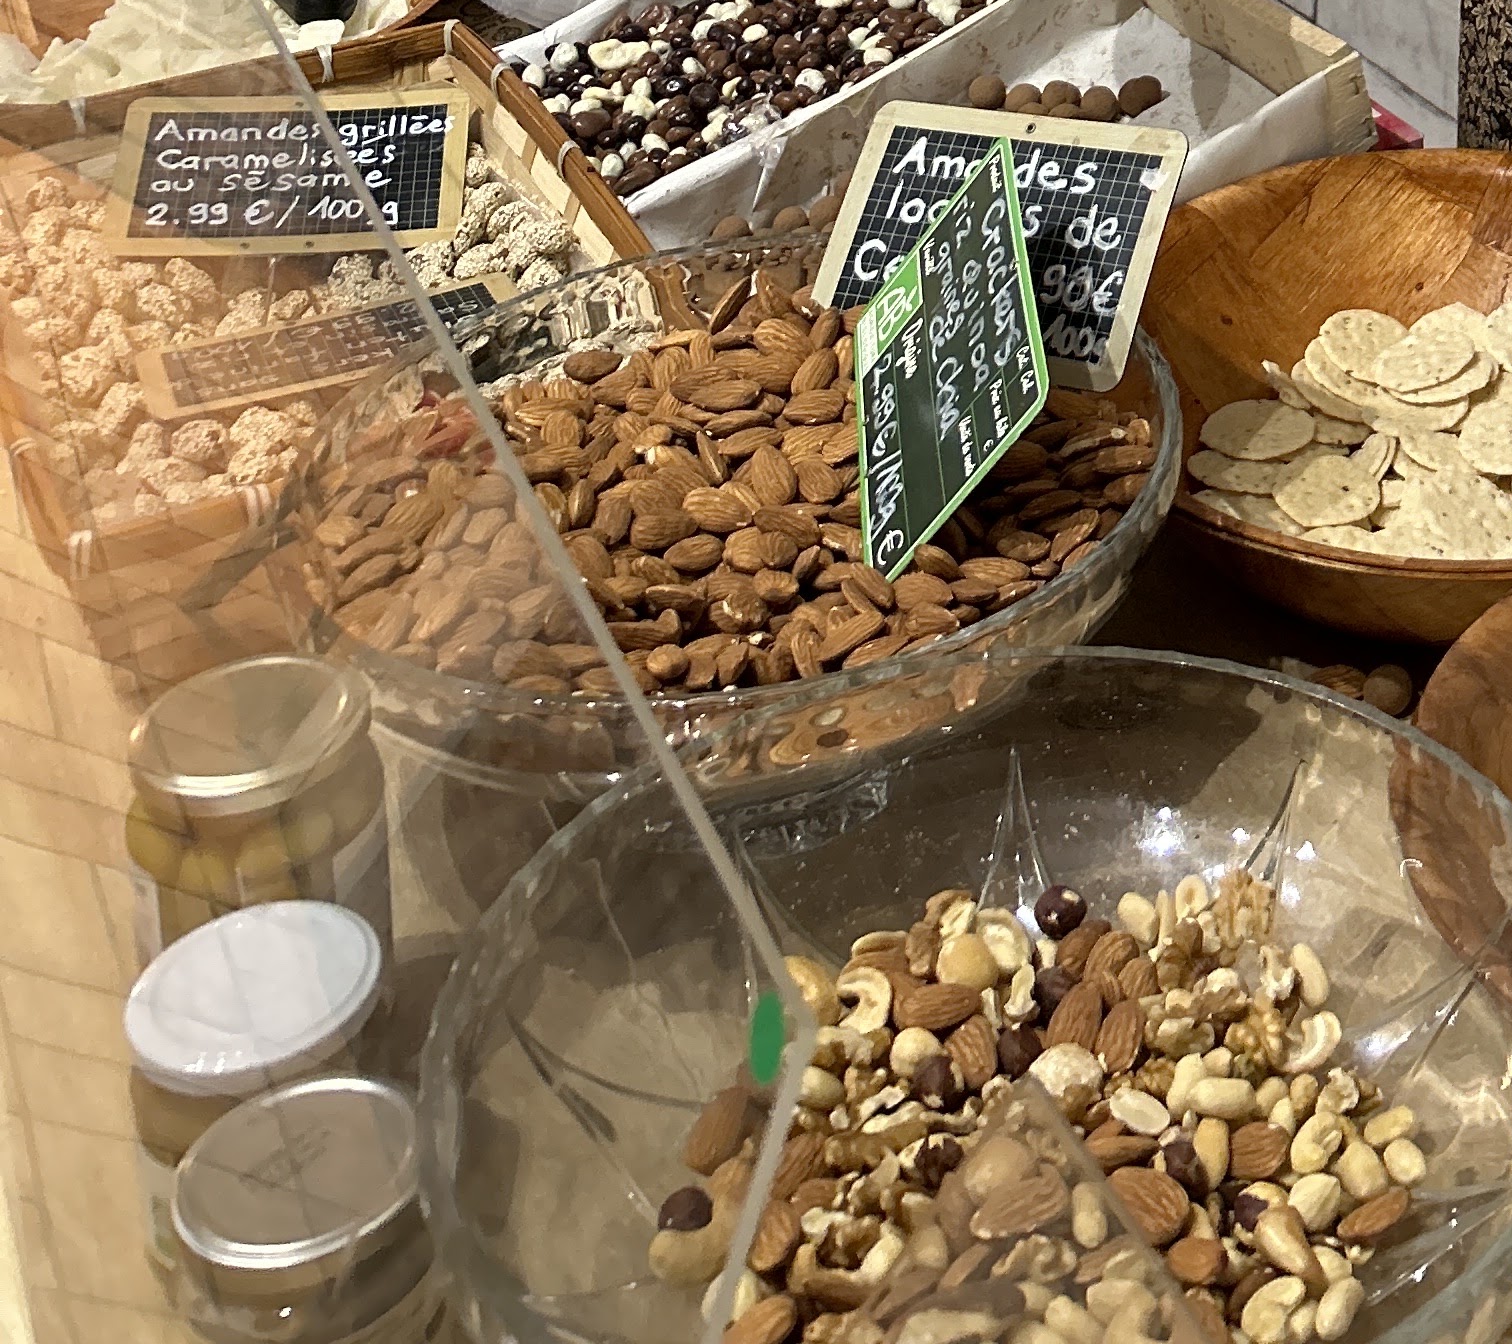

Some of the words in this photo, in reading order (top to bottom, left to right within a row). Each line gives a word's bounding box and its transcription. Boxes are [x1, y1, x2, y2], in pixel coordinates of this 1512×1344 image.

[154, 118, 322, 141] Amandes
[151, 177, 195, 193] au
[145, 201, 229, 226] 2.99
[1066, 204, 1122, 250] de
[981, 198, 1022, 367] Crackers
[877, 285, 918, 342] AB
[961, 259, 990, 392] Quinoa
[895, 317, 923, 379] Origine
[983, 439, 994, 452] €
[877, 528, 904, 566] €
